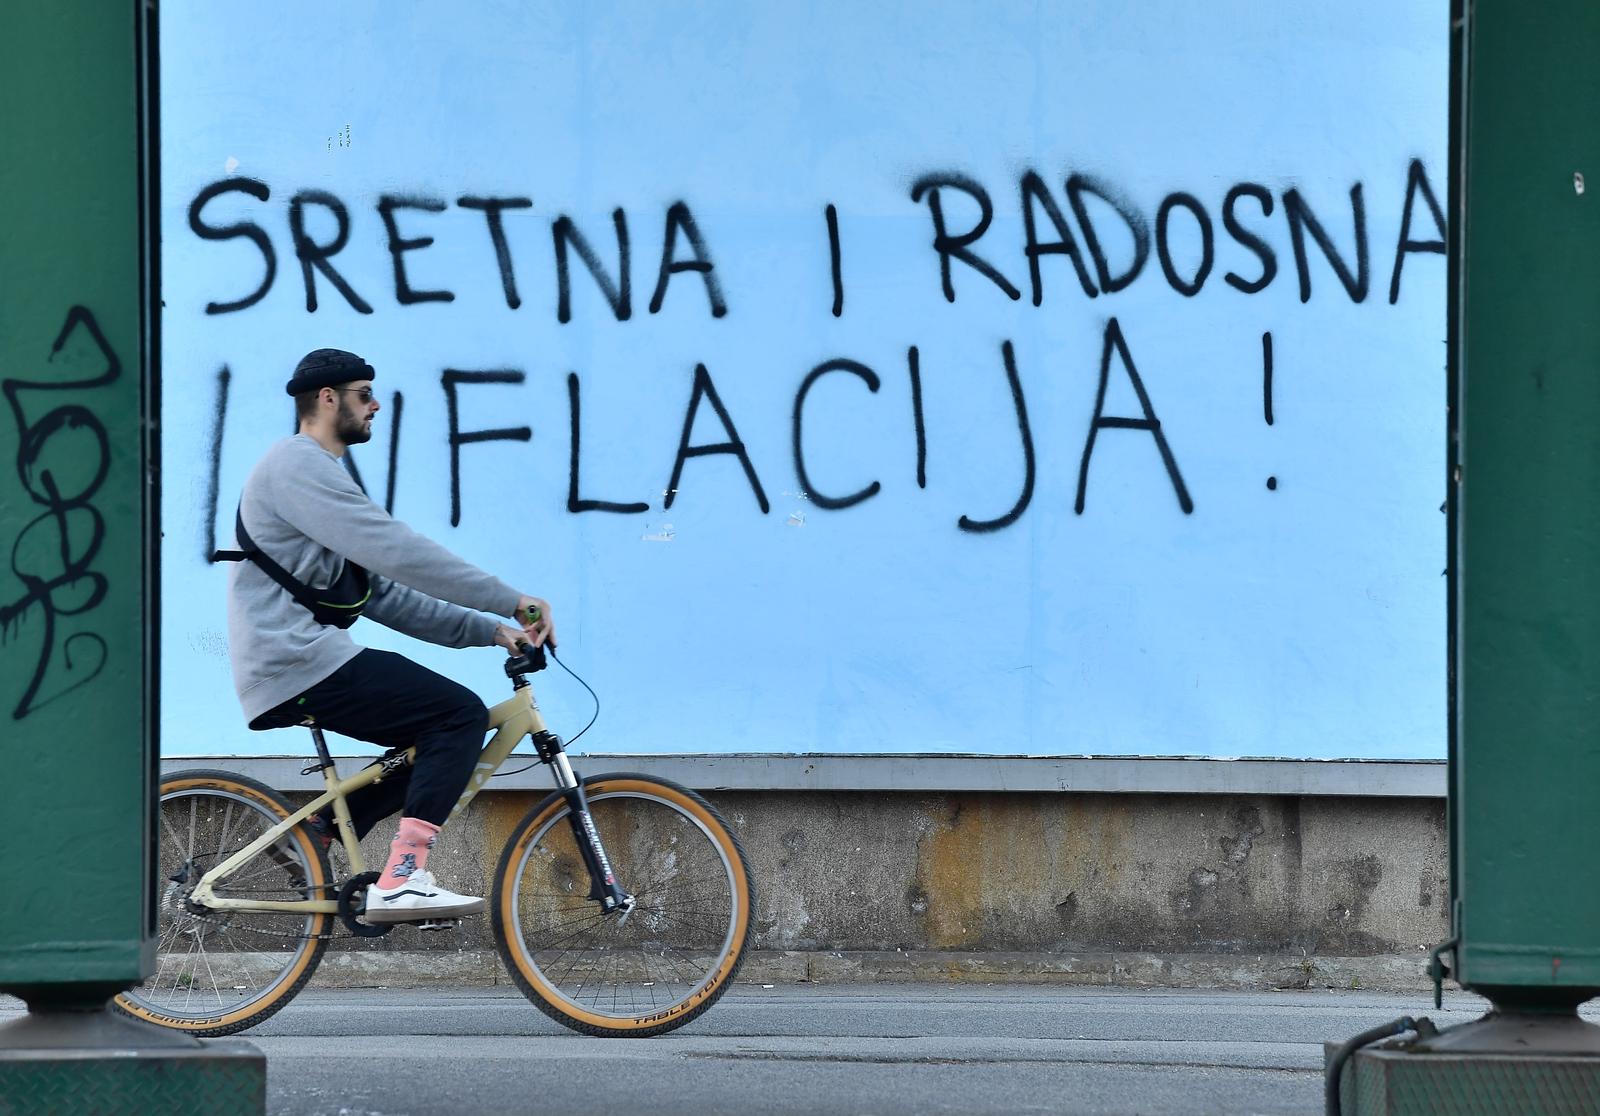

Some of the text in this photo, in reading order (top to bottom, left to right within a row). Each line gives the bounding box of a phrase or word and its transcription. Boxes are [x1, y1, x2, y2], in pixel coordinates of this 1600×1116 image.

[188, 157, 1447, 323] SRETNA I RADOSNA
